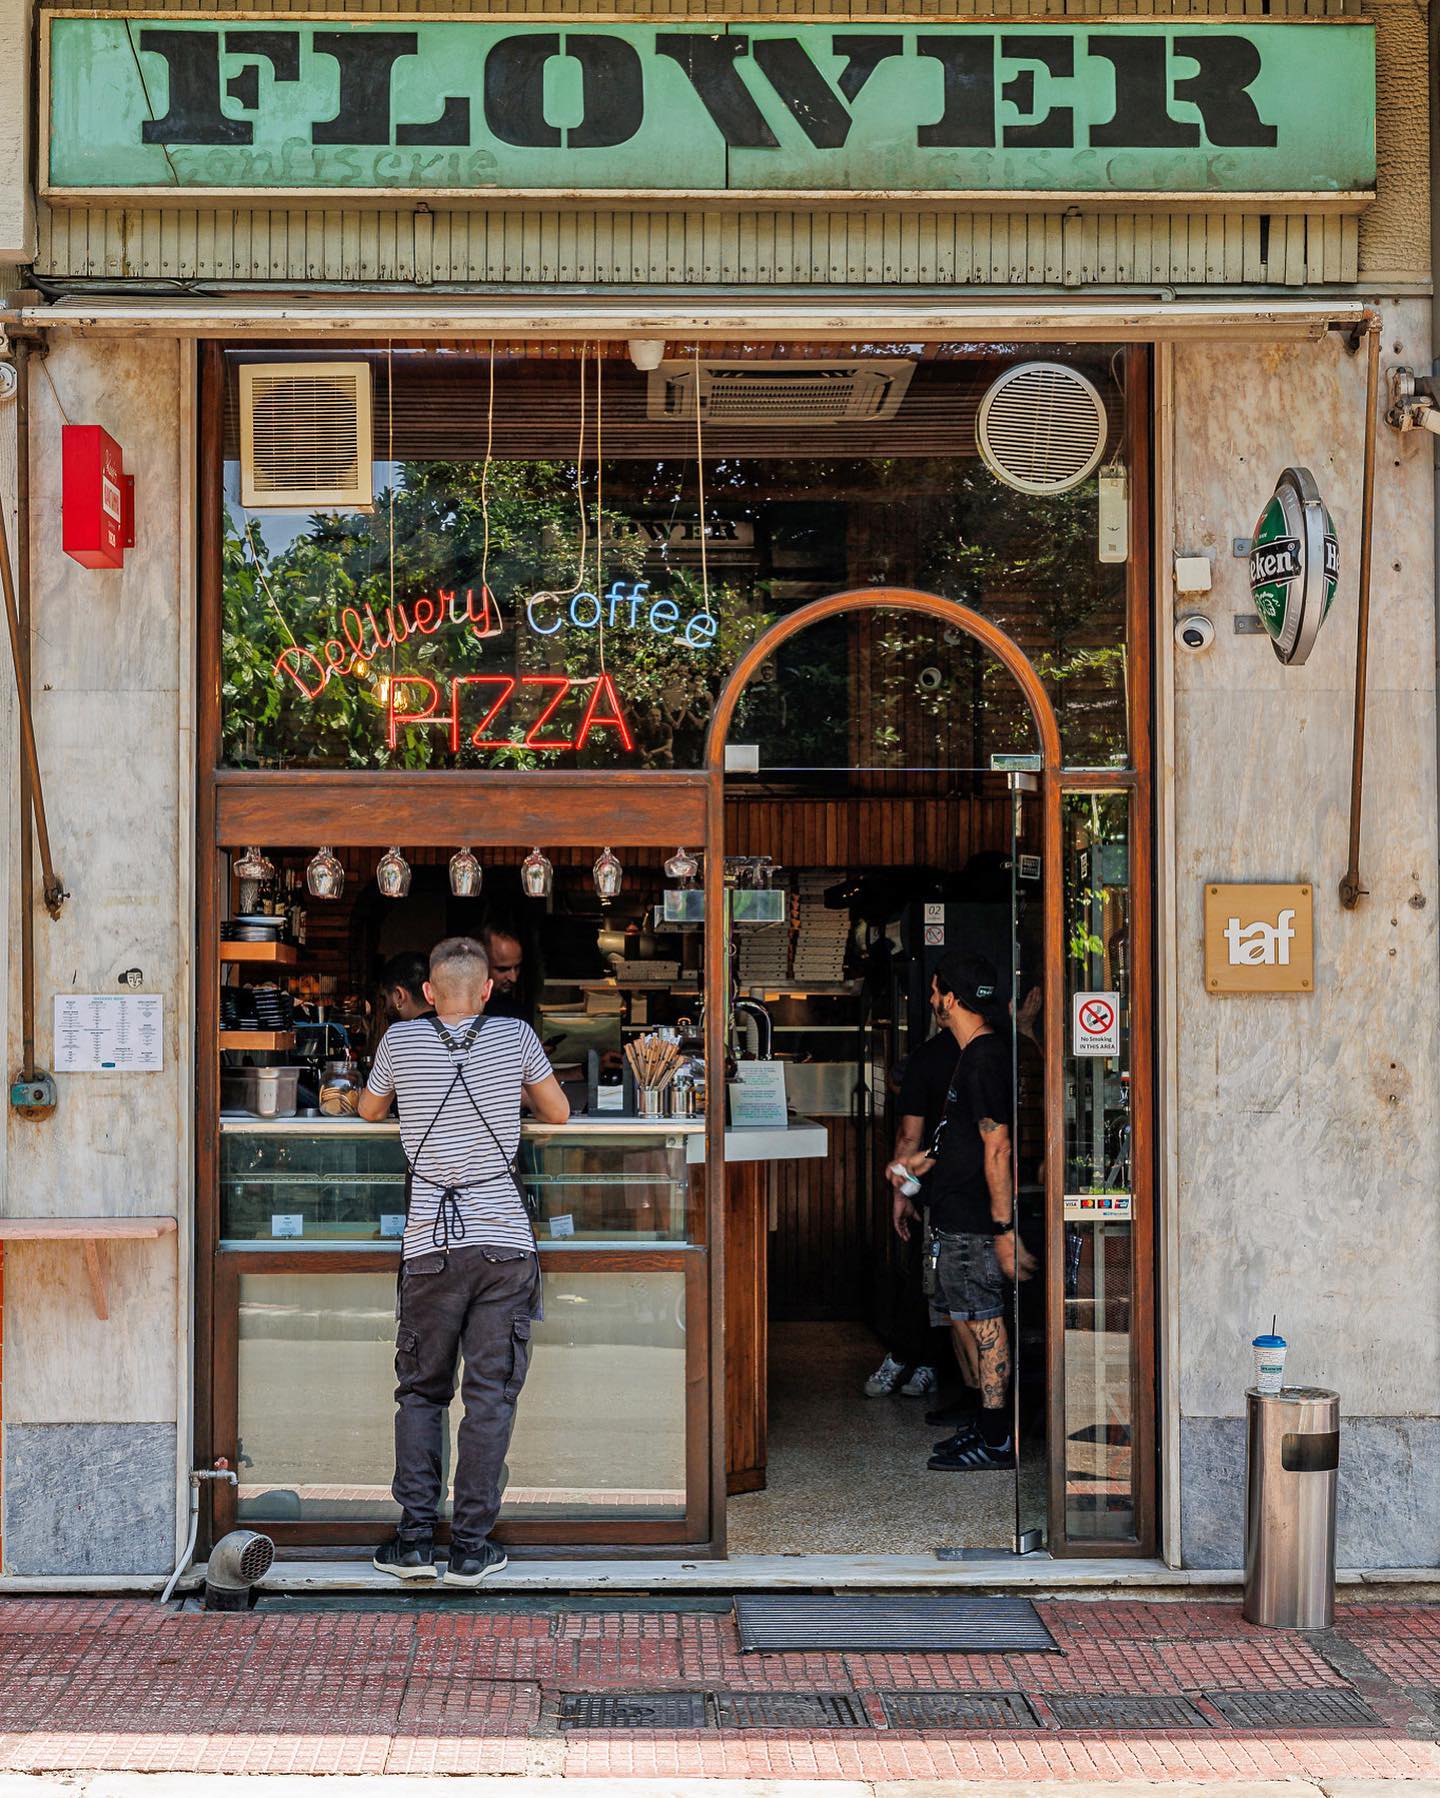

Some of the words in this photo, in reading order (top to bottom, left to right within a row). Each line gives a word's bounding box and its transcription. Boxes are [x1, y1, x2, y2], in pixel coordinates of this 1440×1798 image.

[140, 30, 1278, 149] FLOWER
[273, 585, 491, 699] Delivery
[387, 673, 633, 752] PIZZA
[1223, 908, 1296, 966] taf
